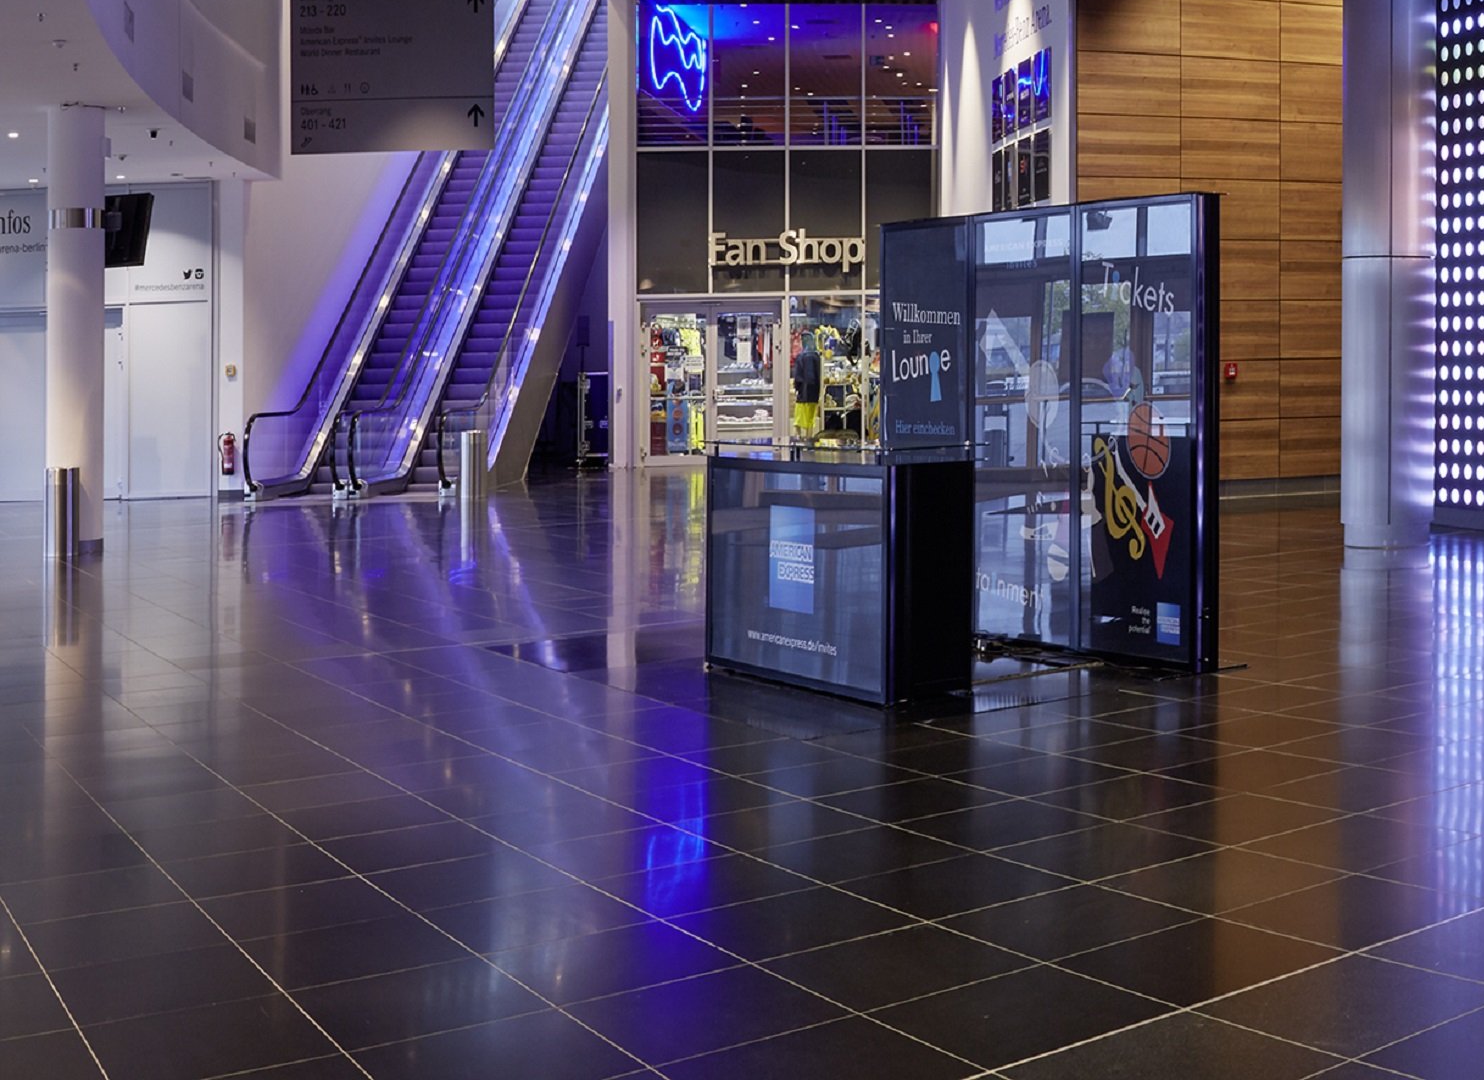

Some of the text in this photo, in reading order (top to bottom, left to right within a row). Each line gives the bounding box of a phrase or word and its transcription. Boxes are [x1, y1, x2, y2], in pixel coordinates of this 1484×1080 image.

[299, 5, 317, 17] 213
[326, 3, 346, 16] 220
[387, 35, 413, 45] Lounge
[301, 118, 318, 130] 401
[328, 117, 346, 129] 421
[709, 228, 865, 273] Fan Shop
[1101, 261, 1175, 316] Tickets
[892, 301, 961, 325] Willkommen
[903, 329, 932, 344] in Ihrer
[896, 419, 956, 436] Hier einchecken
[769, 540, 813, 563] AMERICAN
[777, 562, 815, 584] EXPRESS
